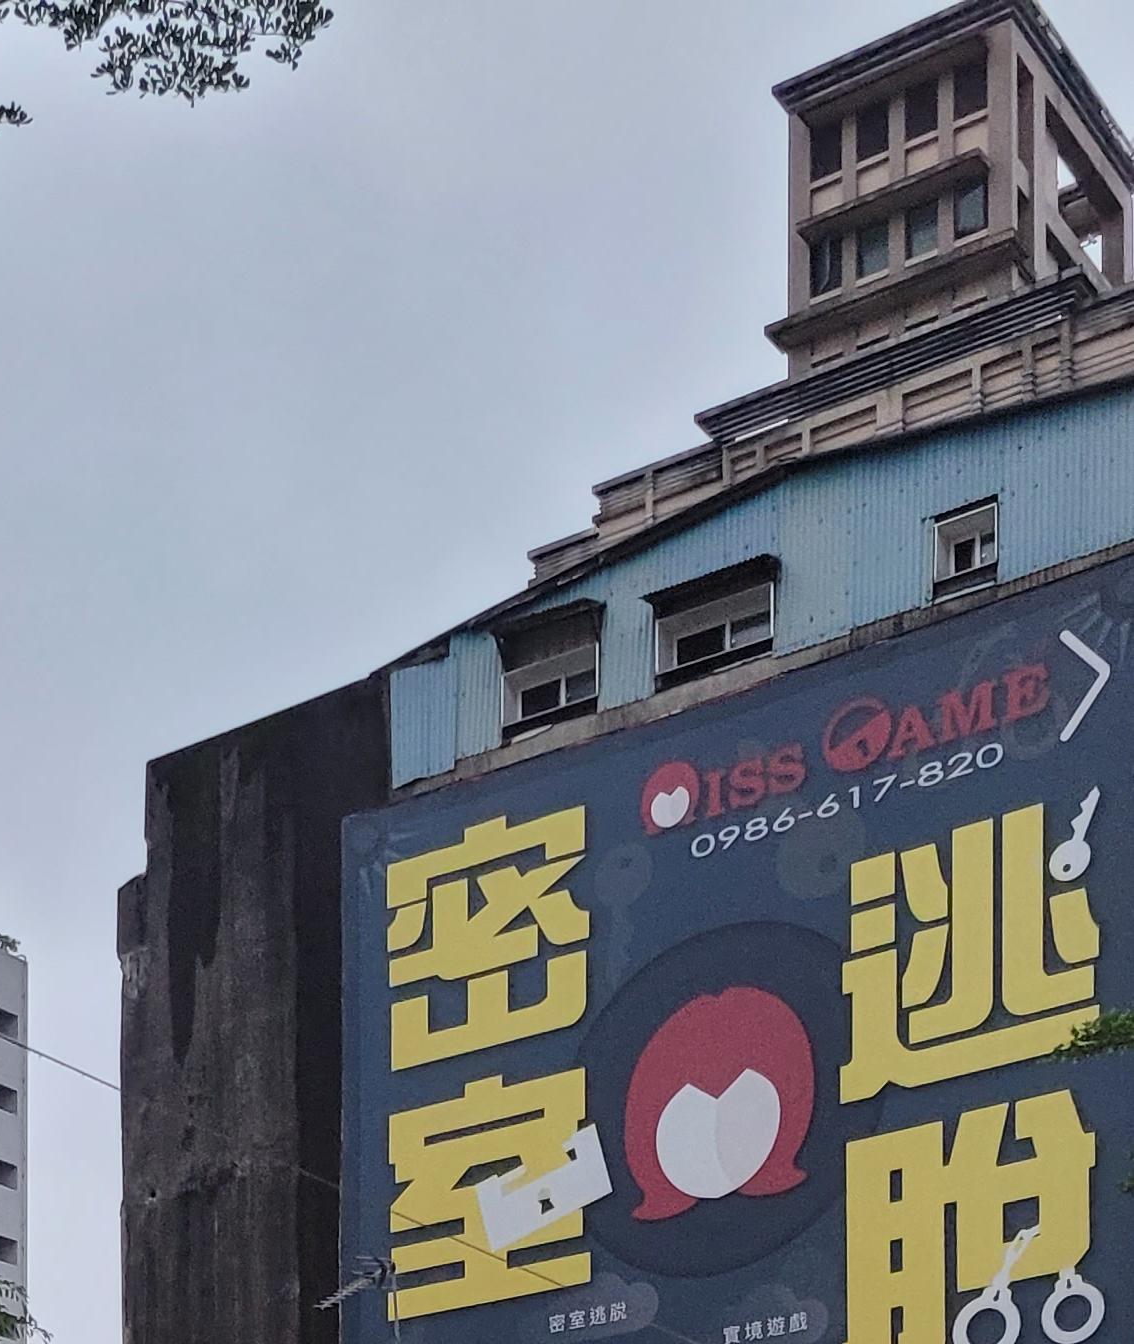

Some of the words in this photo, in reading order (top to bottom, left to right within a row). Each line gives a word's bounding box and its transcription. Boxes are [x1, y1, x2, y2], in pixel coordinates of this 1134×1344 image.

[690, 743, 1005, 858] 0986-617-820
[386, 805, 592, 1322] 密室
[548, 1302, 627, 1334] 密室逃脫
